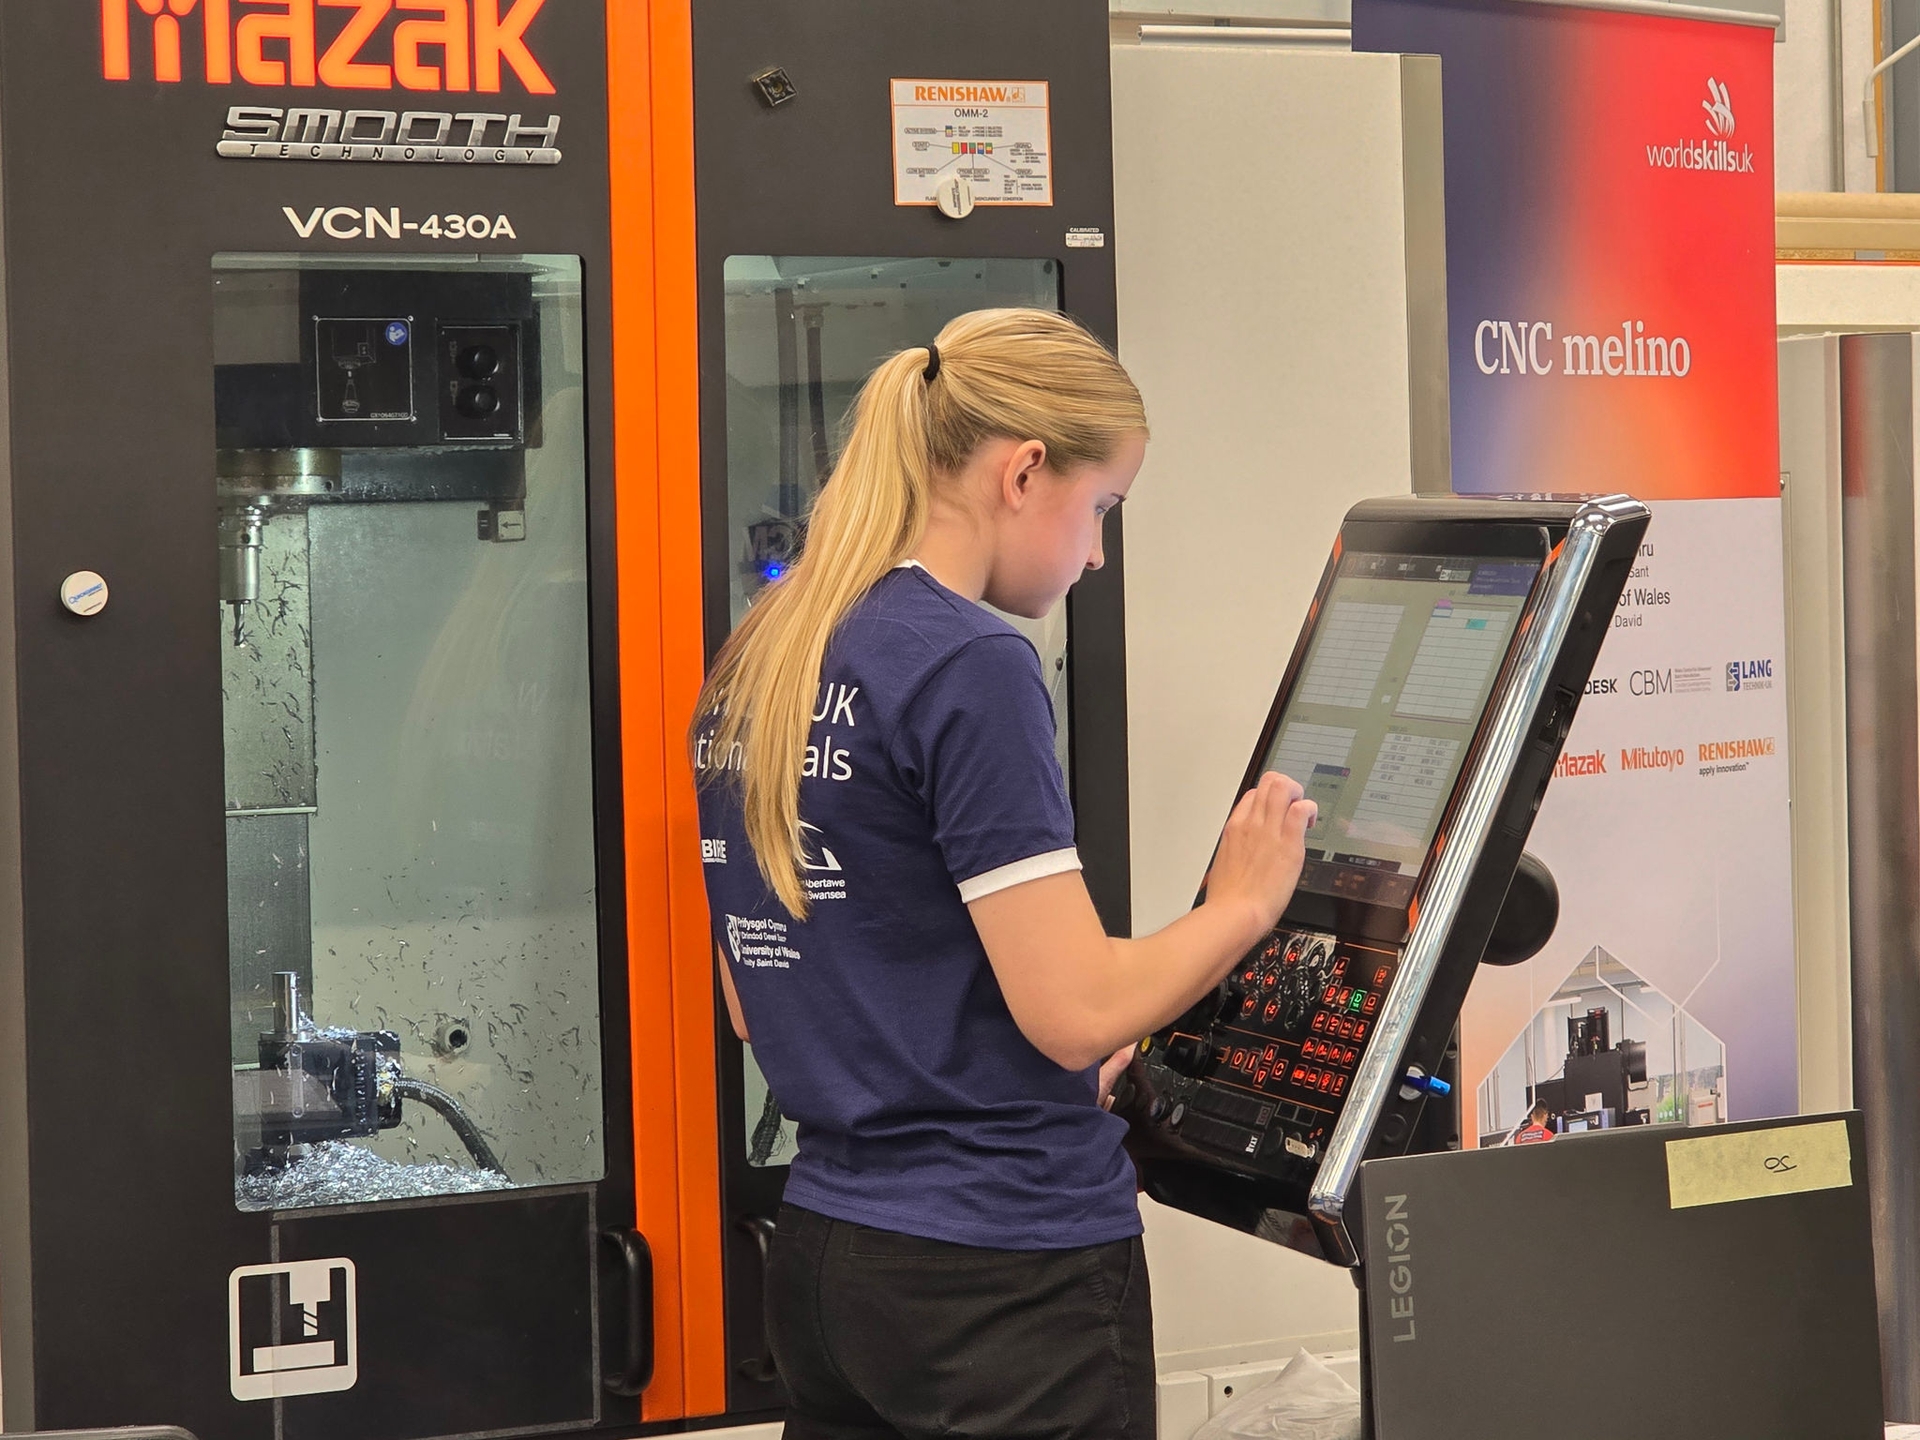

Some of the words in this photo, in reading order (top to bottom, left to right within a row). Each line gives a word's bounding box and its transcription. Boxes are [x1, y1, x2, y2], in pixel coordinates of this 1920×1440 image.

[102, 0, 557, 94] Mazak
[915, 85, 1008, 103] RENISHAW
[954, 108, 989, 118] OMM-2
[222, 106, 561, 147] SMOOTH
[249, 143, 535, 162] TECHNOLOGY
[1646, 138, 1755, 173] worldskillsuk
[282, 207, 517, 239] VCN-430A
[1474, 319, 1553, 376] CNC
[1562, 320, 1691, 377] melino
[1638, 543, 1654, 557] ru
[1628, 566, 1650, 578] Sant
[1634, 588, 1671, 606] Wales
[1614, 614, 1643, 628] David
[1742, 659, 1772, 679] LANG
[1584, 678, 1618, 695] DESK
[1629, 668, 1673, 696] CBM
[801, 736, 853, 781] als
[1621, 746, 1685, 772] Mitutoyo
[1698, 738, 1765, 762] RENISHAW
[1699, 766, 1715, 777] apply
[807, 891, 847, 900] Swansea
[1384, 1194, 1416, 1343] LEGION
